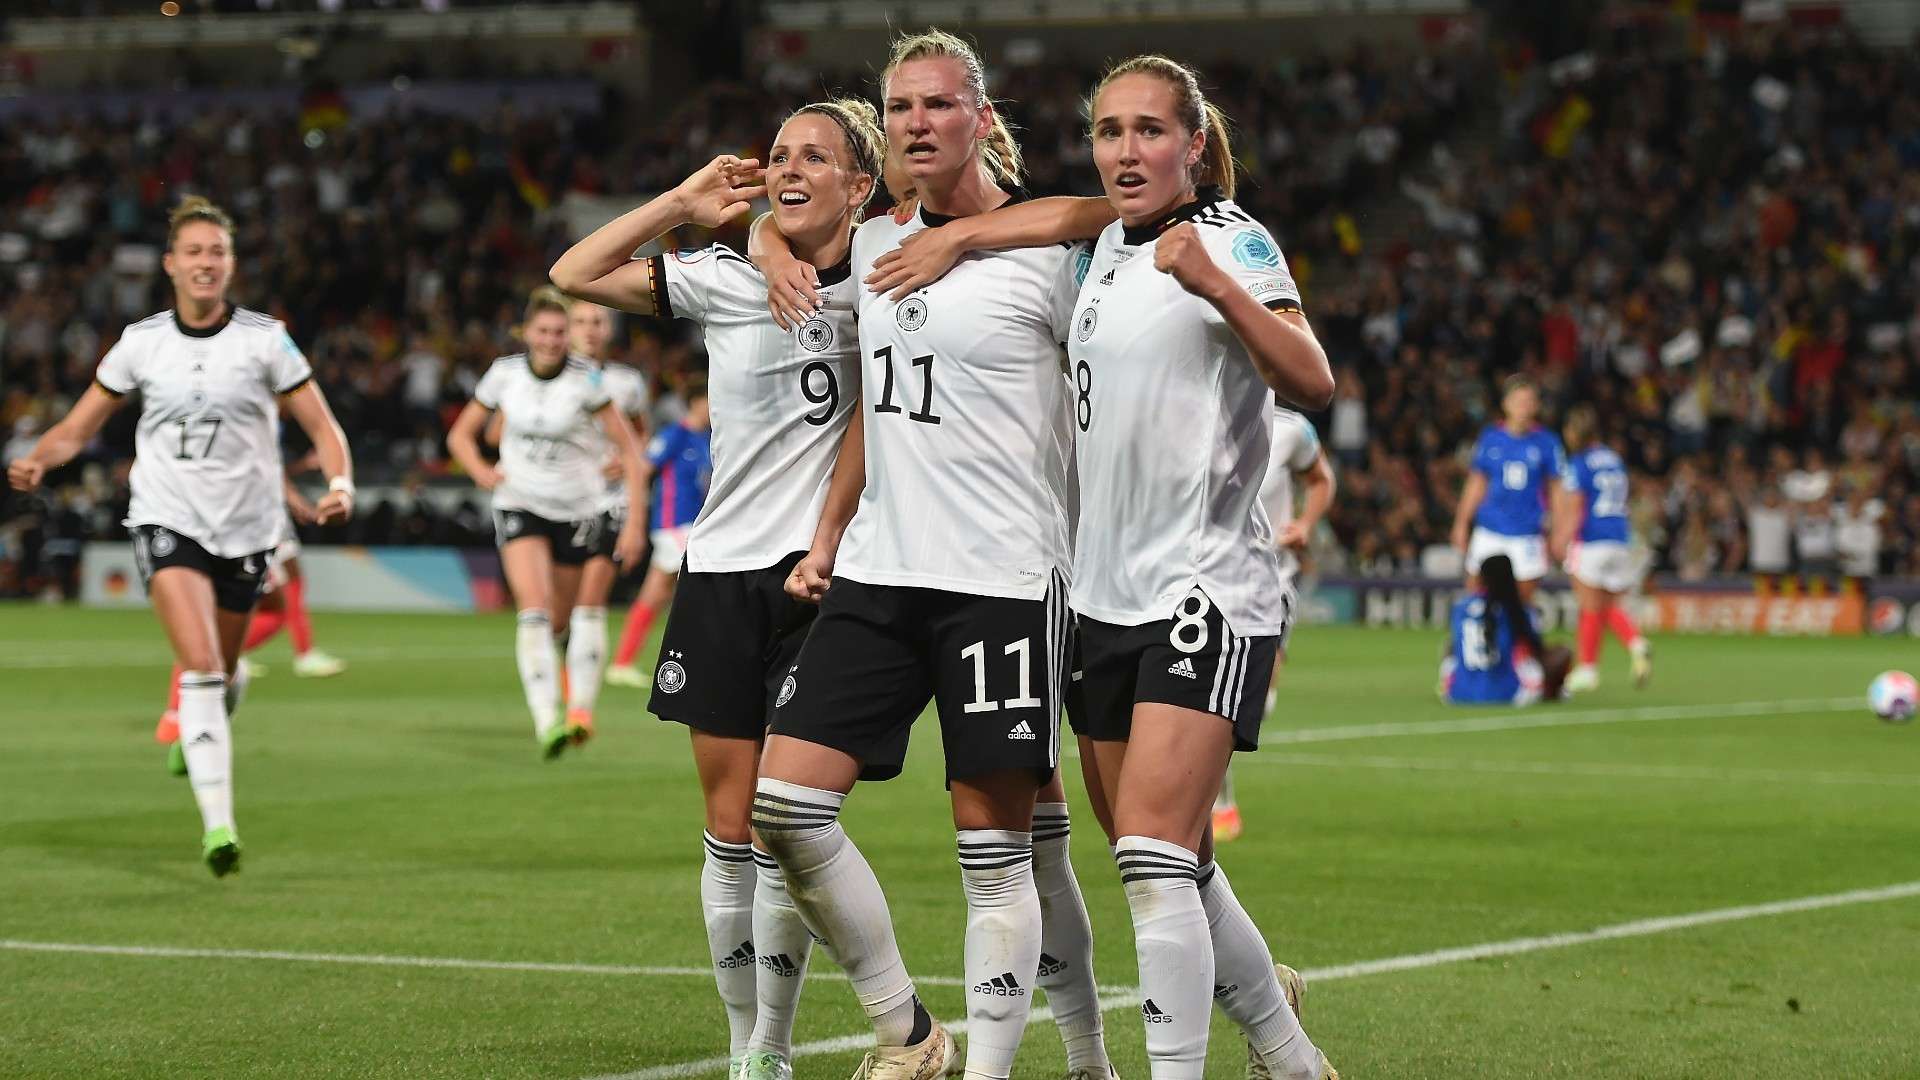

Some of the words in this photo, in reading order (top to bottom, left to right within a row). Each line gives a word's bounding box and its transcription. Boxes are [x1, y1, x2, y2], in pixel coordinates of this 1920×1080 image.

[801, 361, 839, 426] 9
[873, 345, 941, 425] 11
[1077, 360, 1092, 433] 8
[174, 415, 223, 460] 17
[1169, 587, 1210, 653] 8
[961, 637, 1041, 713] 11
[1167, 666, 1197, 680] adidas
[1007, 732, 1036, 741] adidas
[758, 955, 800, 978] adidas
[973, 984, 1025, 997] adidas
